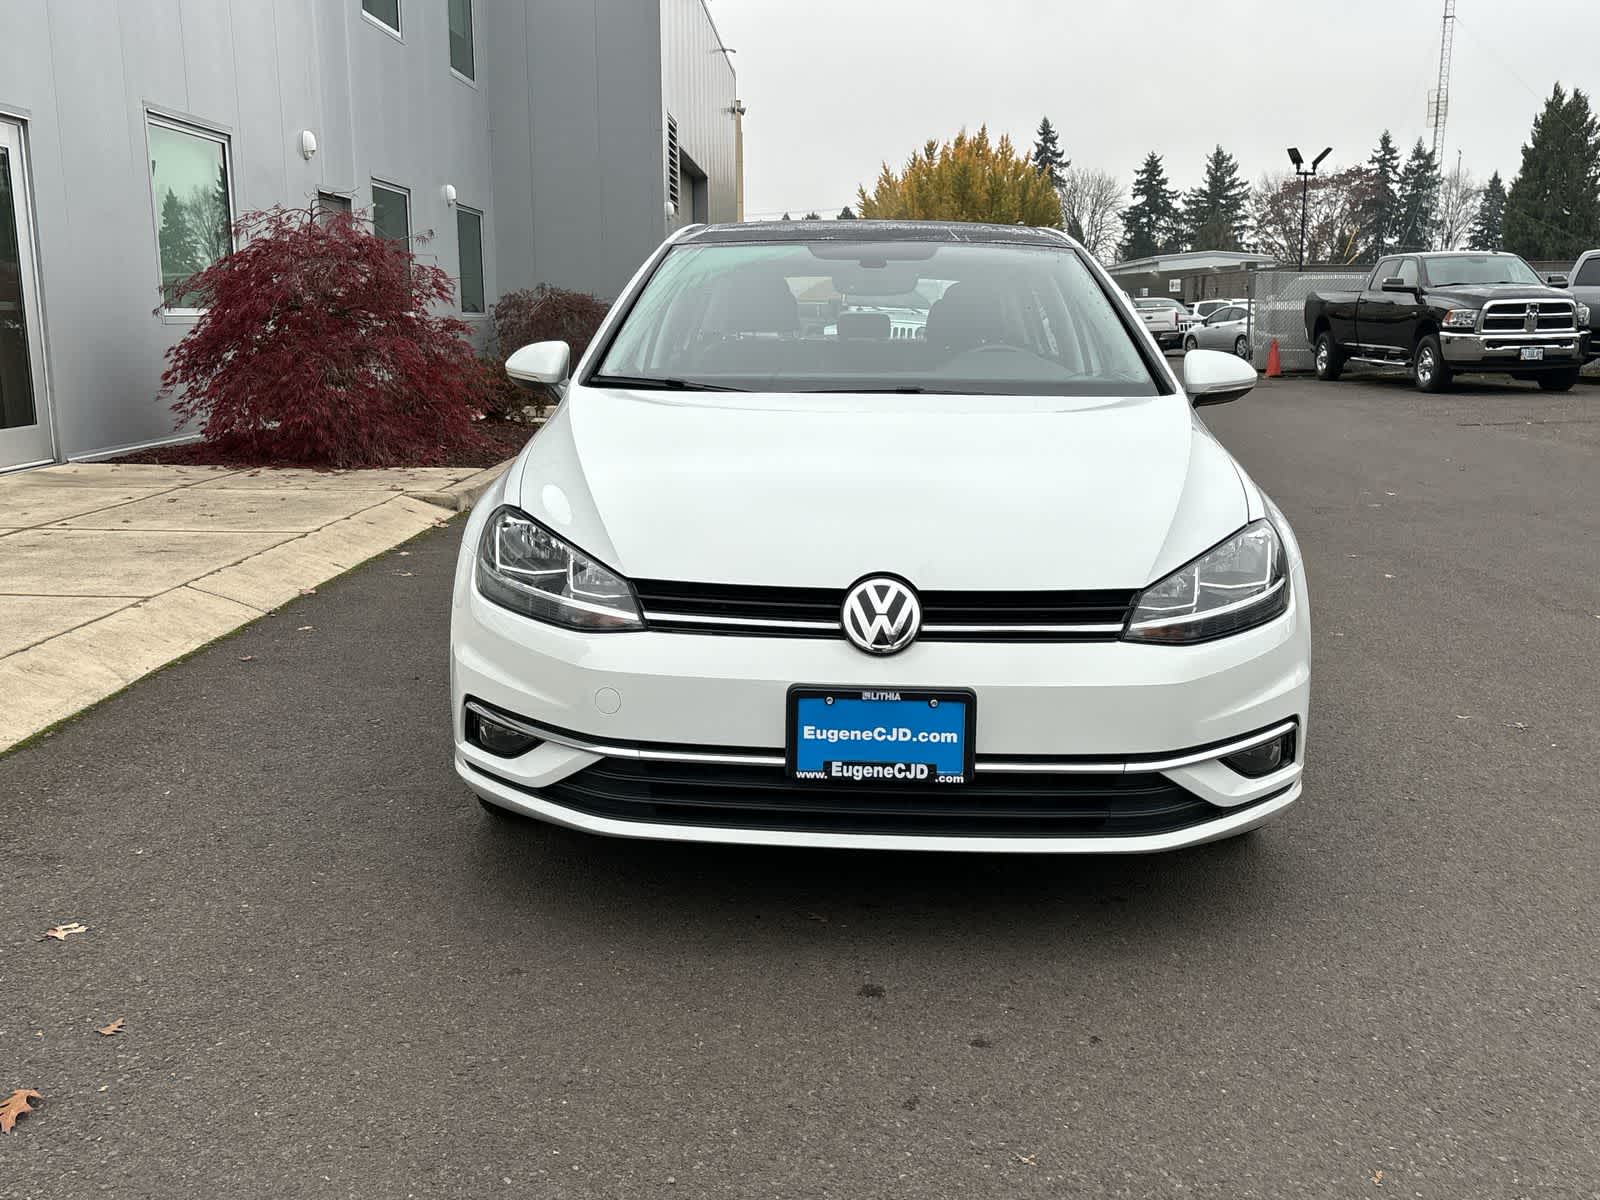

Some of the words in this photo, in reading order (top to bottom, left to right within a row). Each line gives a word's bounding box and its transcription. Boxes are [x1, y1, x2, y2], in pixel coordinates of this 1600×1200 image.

[846, 576, 917, 648] VW
[871, 692, 902, 701] LITHIA
[803, 725, 958, 743] EugeneCJD.com
[795, 771, 828, 780] www.
[831, 761, 929, 780] EugeneCJD
[934, 774, 965, 783] .com
